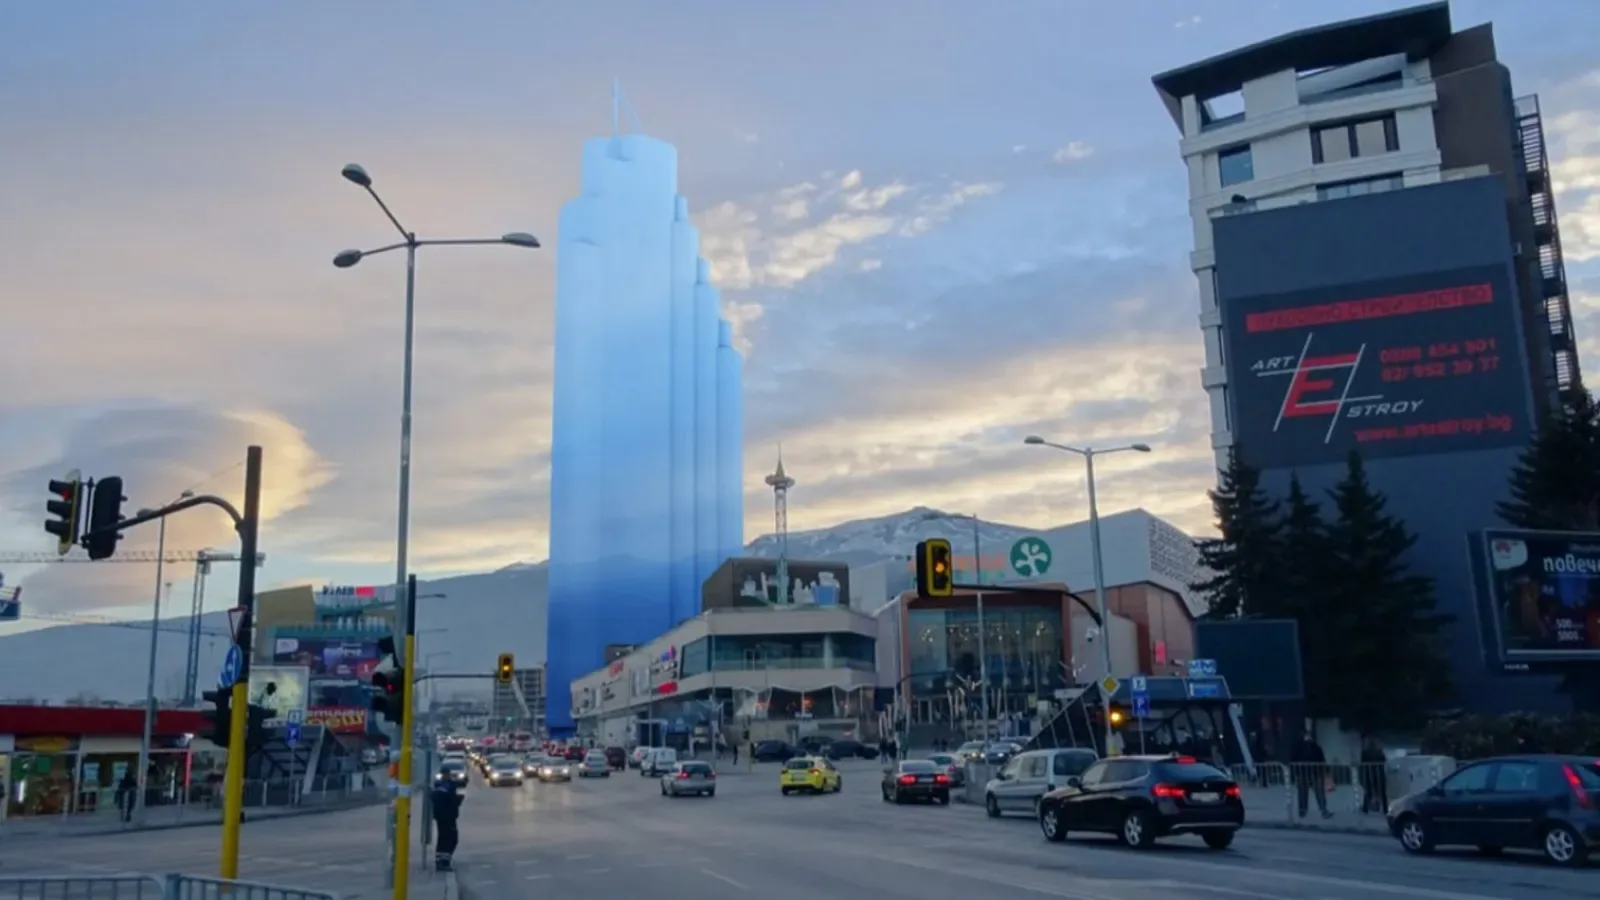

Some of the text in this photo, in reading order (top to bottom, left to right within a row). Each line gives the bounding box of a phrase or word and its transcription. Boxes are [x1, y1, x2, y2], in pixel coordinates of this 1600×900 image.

[1250, 355, 1295, 371] ART
[1282, 352, 1359, 419] E
[1347, 398, 1424, 418] STROY
